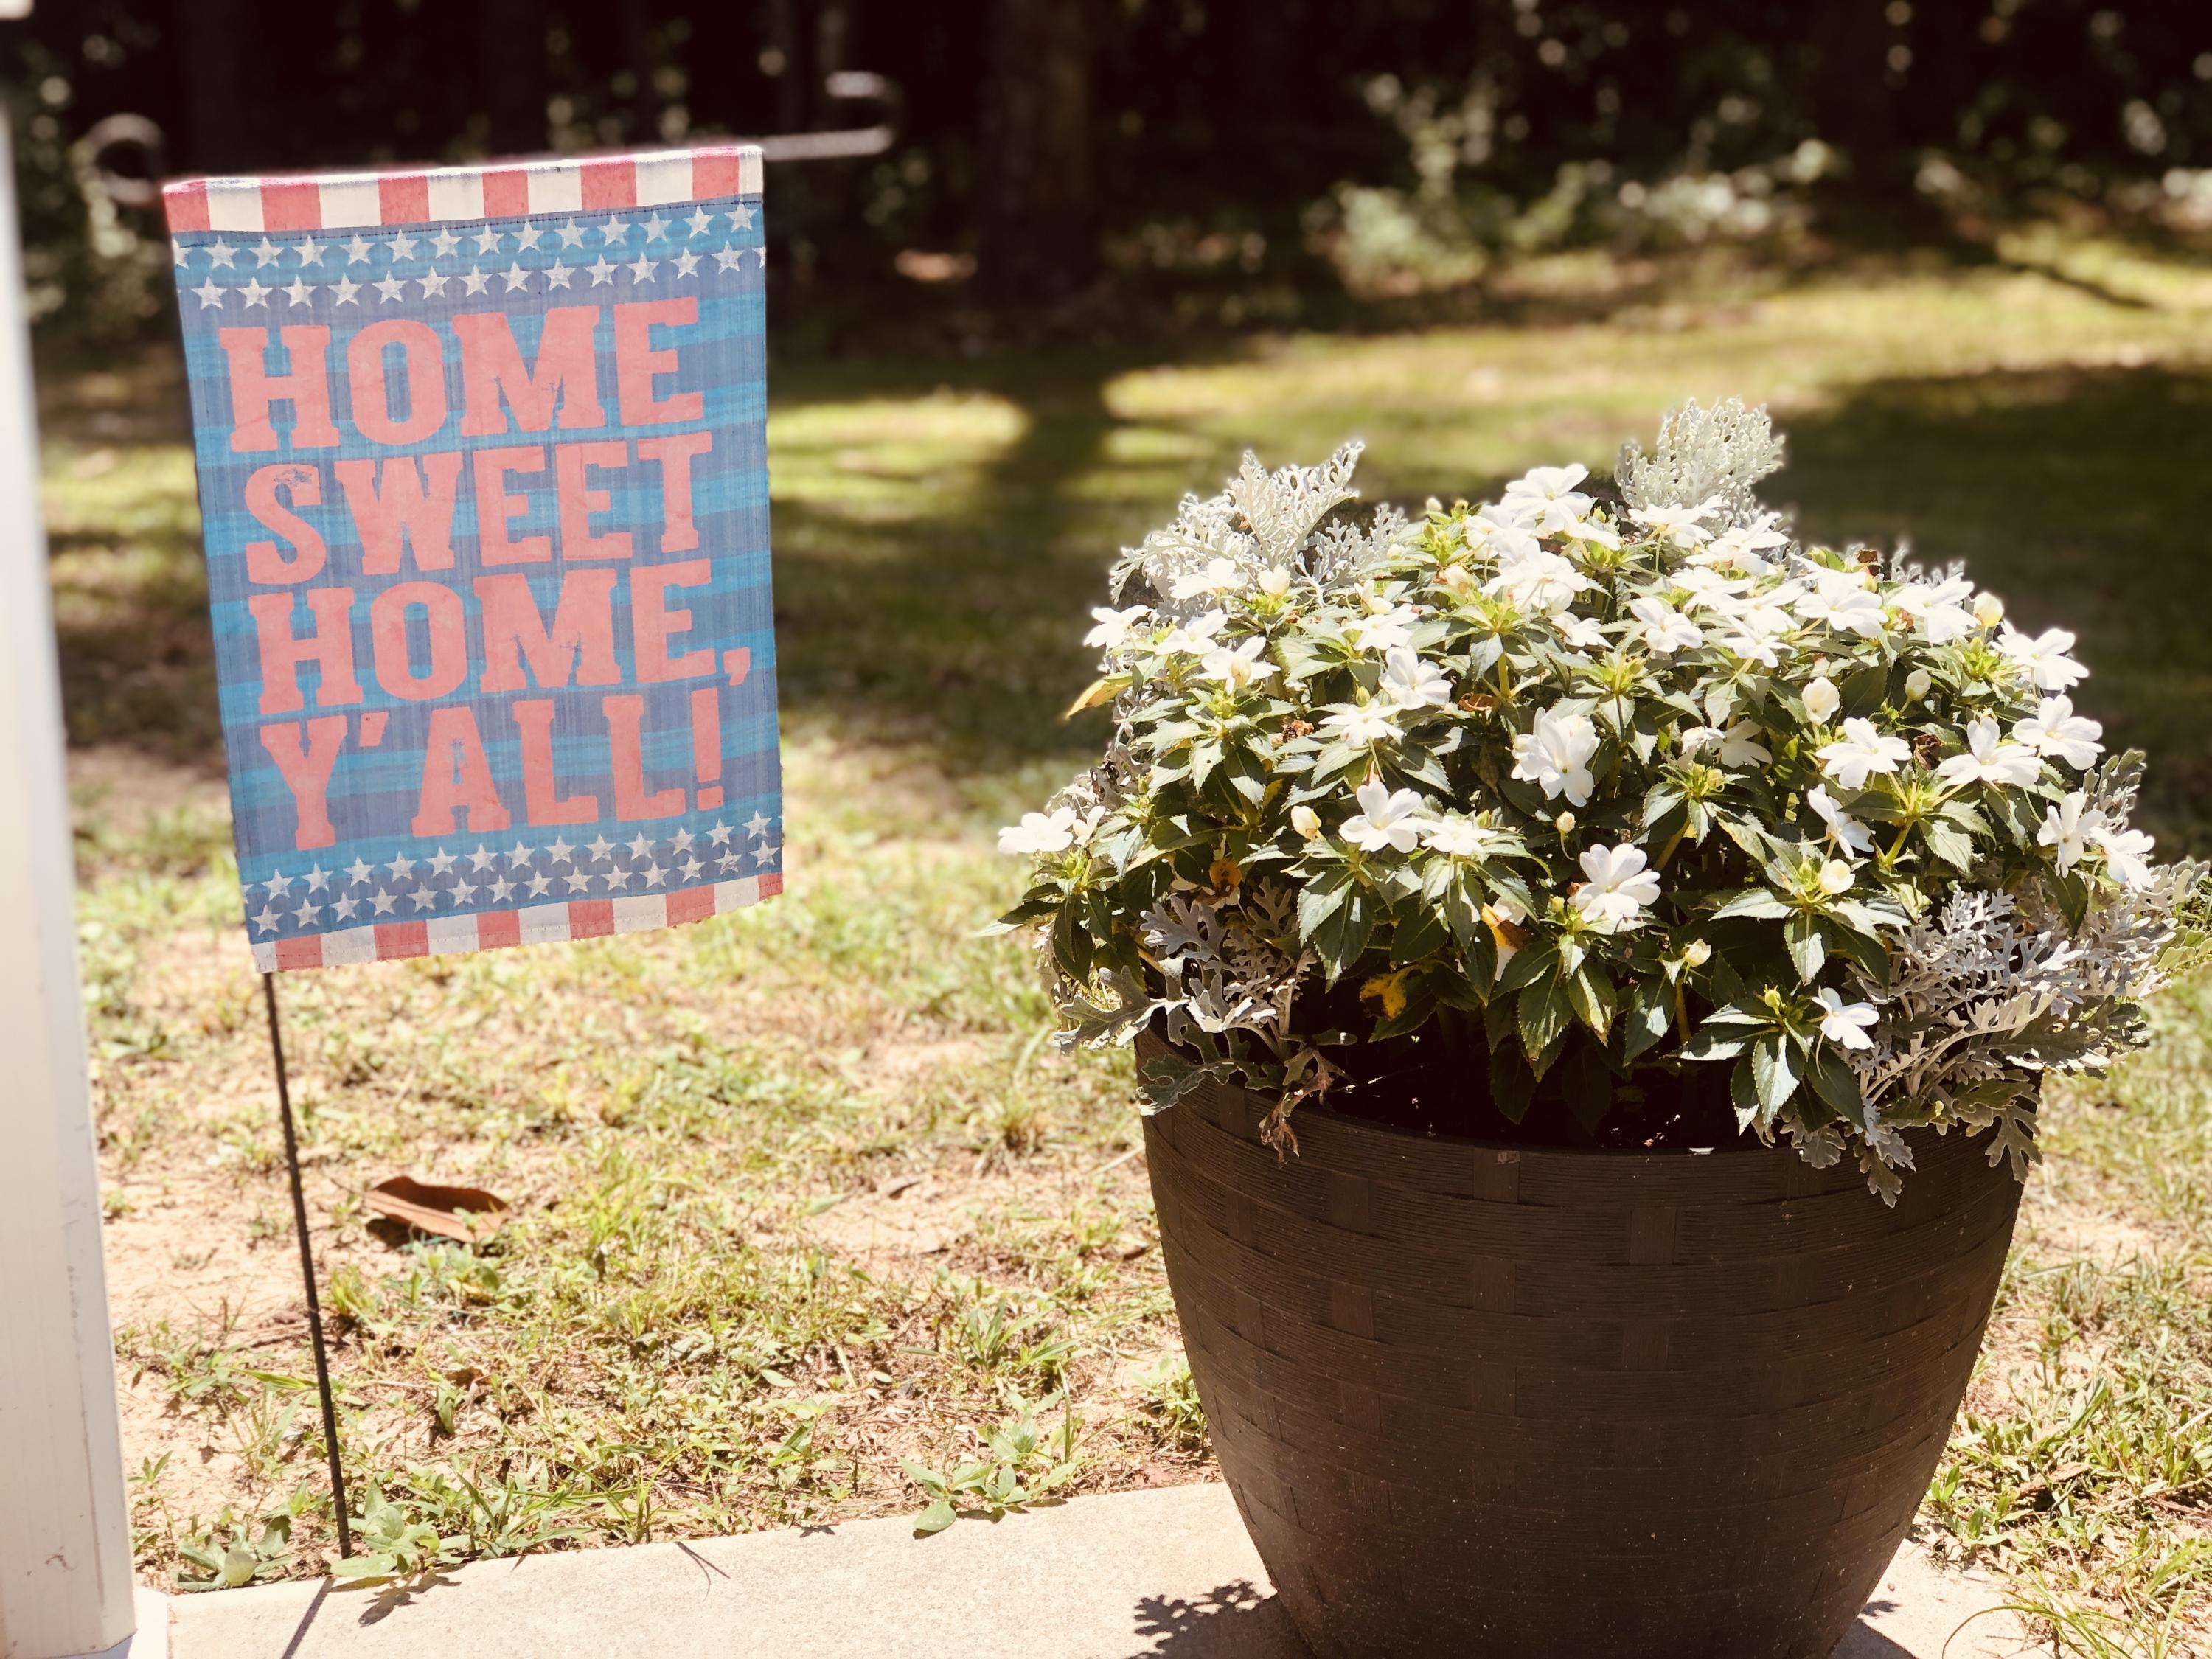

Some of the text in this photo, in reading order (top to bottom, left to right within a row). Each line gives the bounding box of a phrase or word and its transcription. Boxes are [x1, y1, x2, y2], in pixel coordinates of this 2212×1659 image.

[220, 296, 703, 451] HOME
[246, 432, 712, 585] SWEET
[249, 560, 749, 714] HOME,
[260, 689, 723, 849] Y'ALL!
